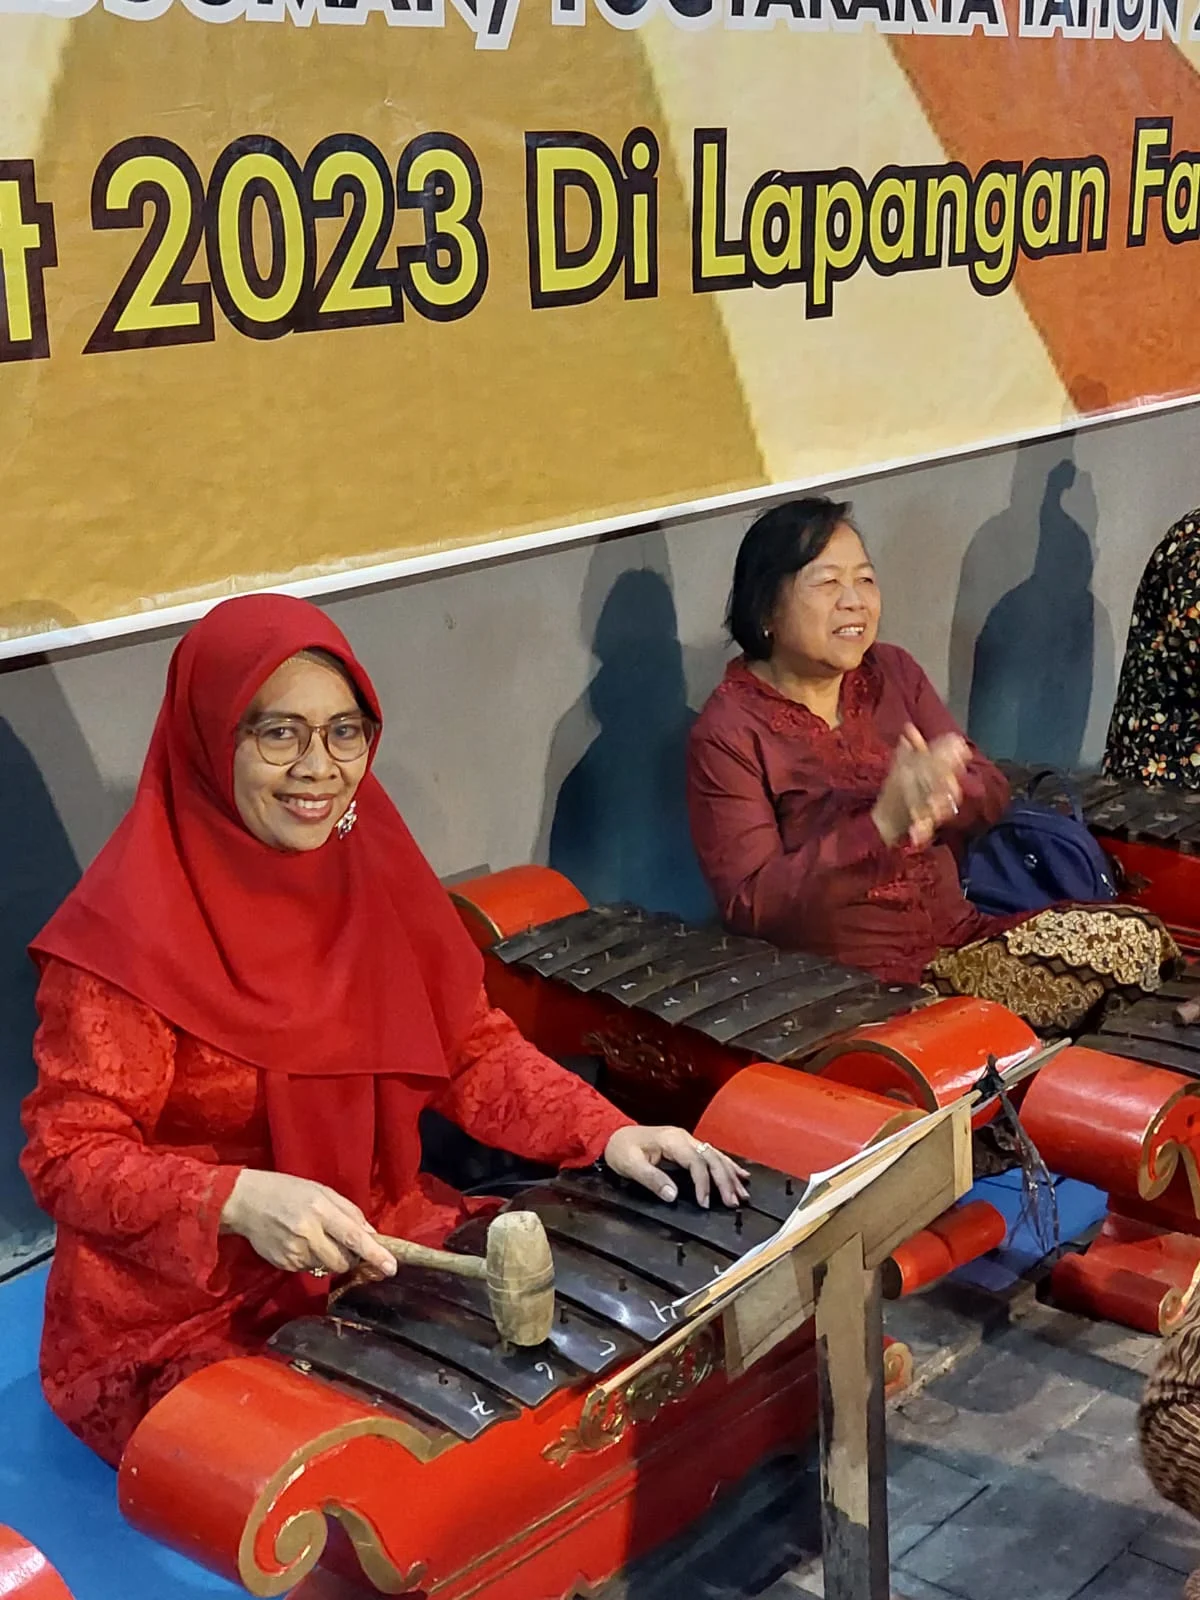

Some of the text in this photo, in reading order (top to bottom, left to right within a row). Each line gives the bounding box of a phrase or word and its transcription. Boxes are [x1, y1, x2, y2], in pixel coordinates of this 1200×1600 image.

[88, 134, 487, 350] 2023
[527, 127, 657, 308] Di
[693, 128, 1108, 317] Lapangan
